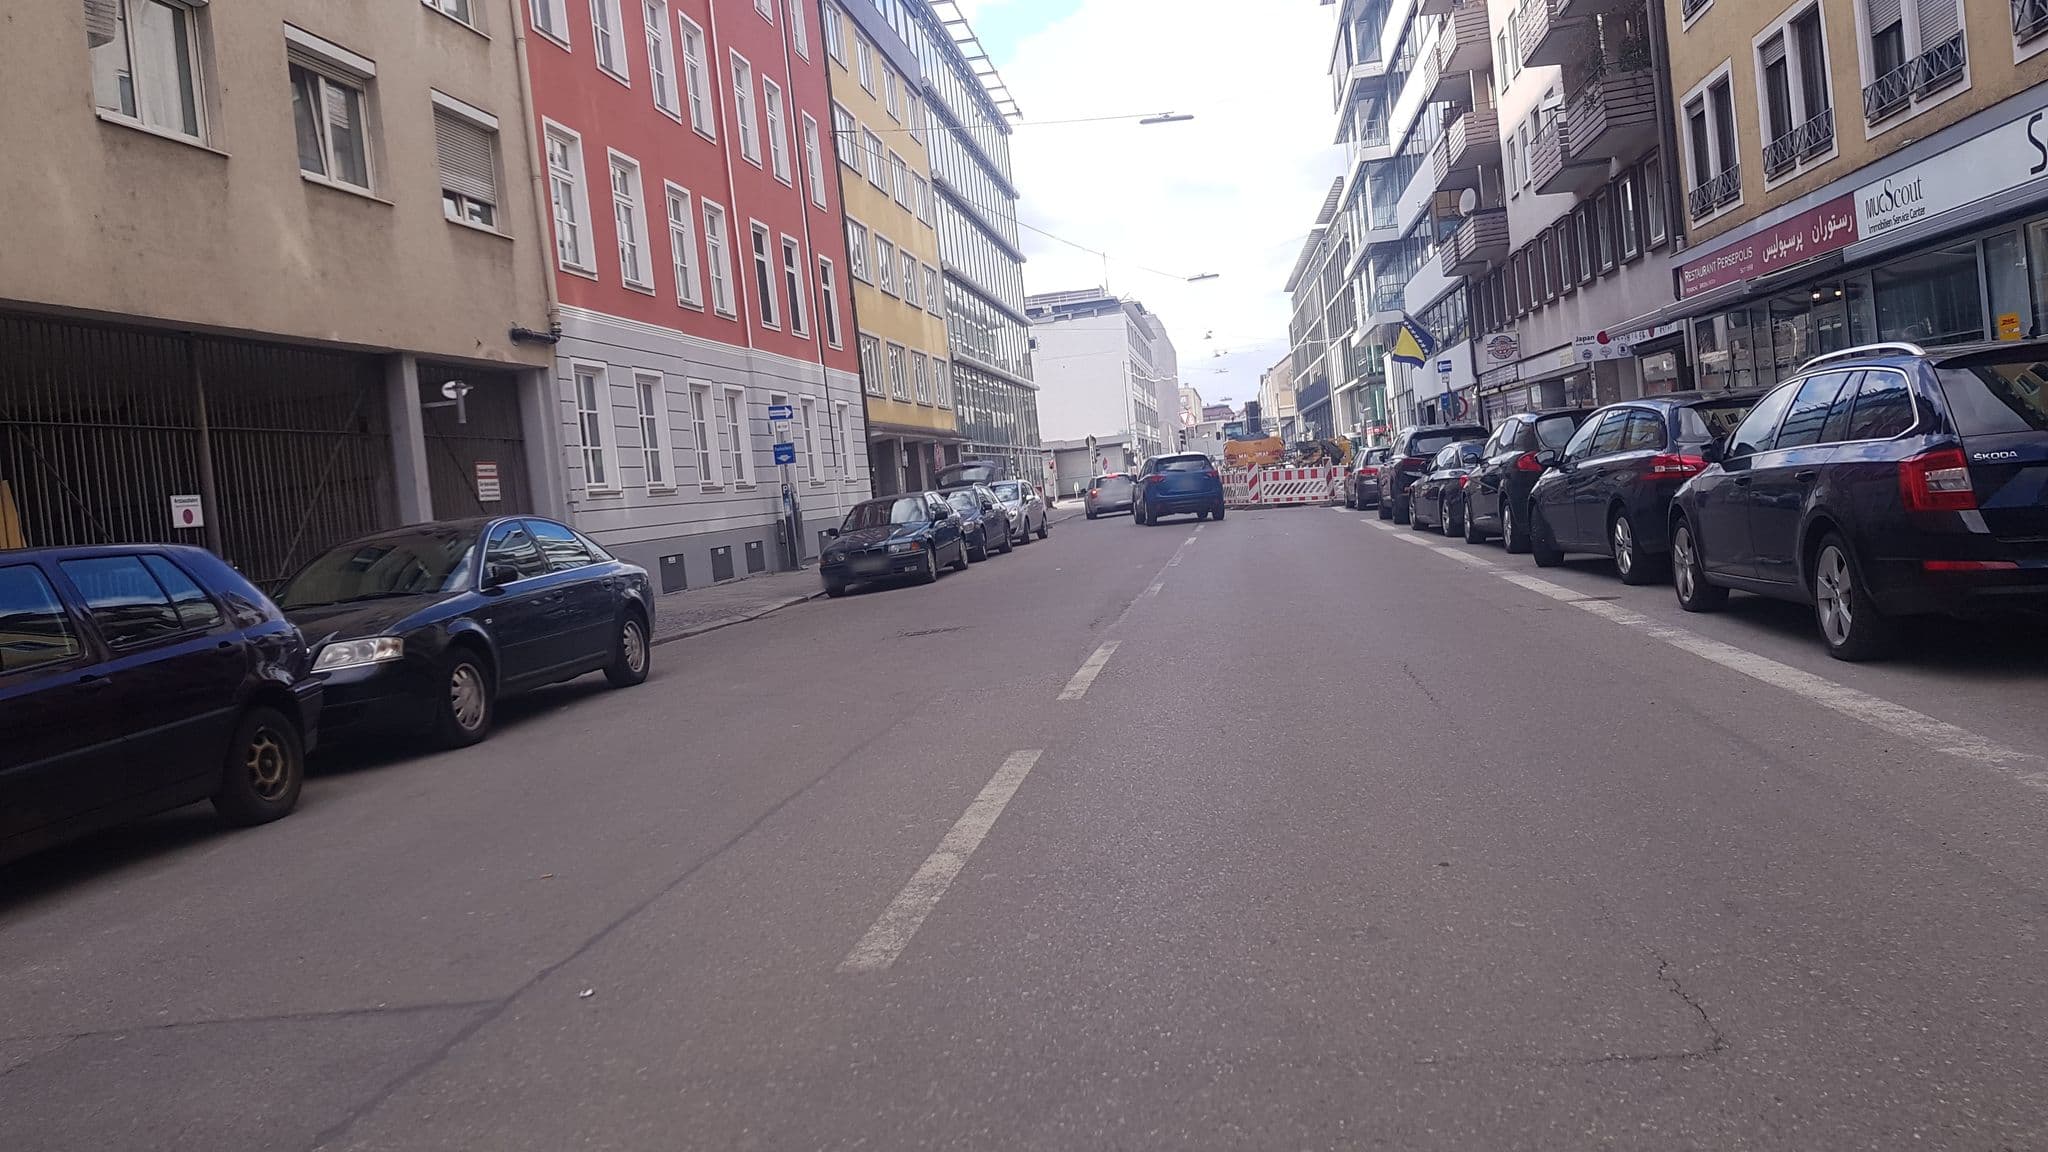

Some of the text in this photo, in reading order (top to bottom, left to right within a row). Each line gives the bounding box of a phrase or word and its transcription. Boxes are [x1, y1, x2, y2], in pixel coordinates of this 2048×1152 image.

[2027, 112, 2048, 176] S
[1811, 212, 1853, 244] رستوران
[1868, 206, 1926, 234] Immobilien Service Center
[1575, 334, 1595, 343] Japan
